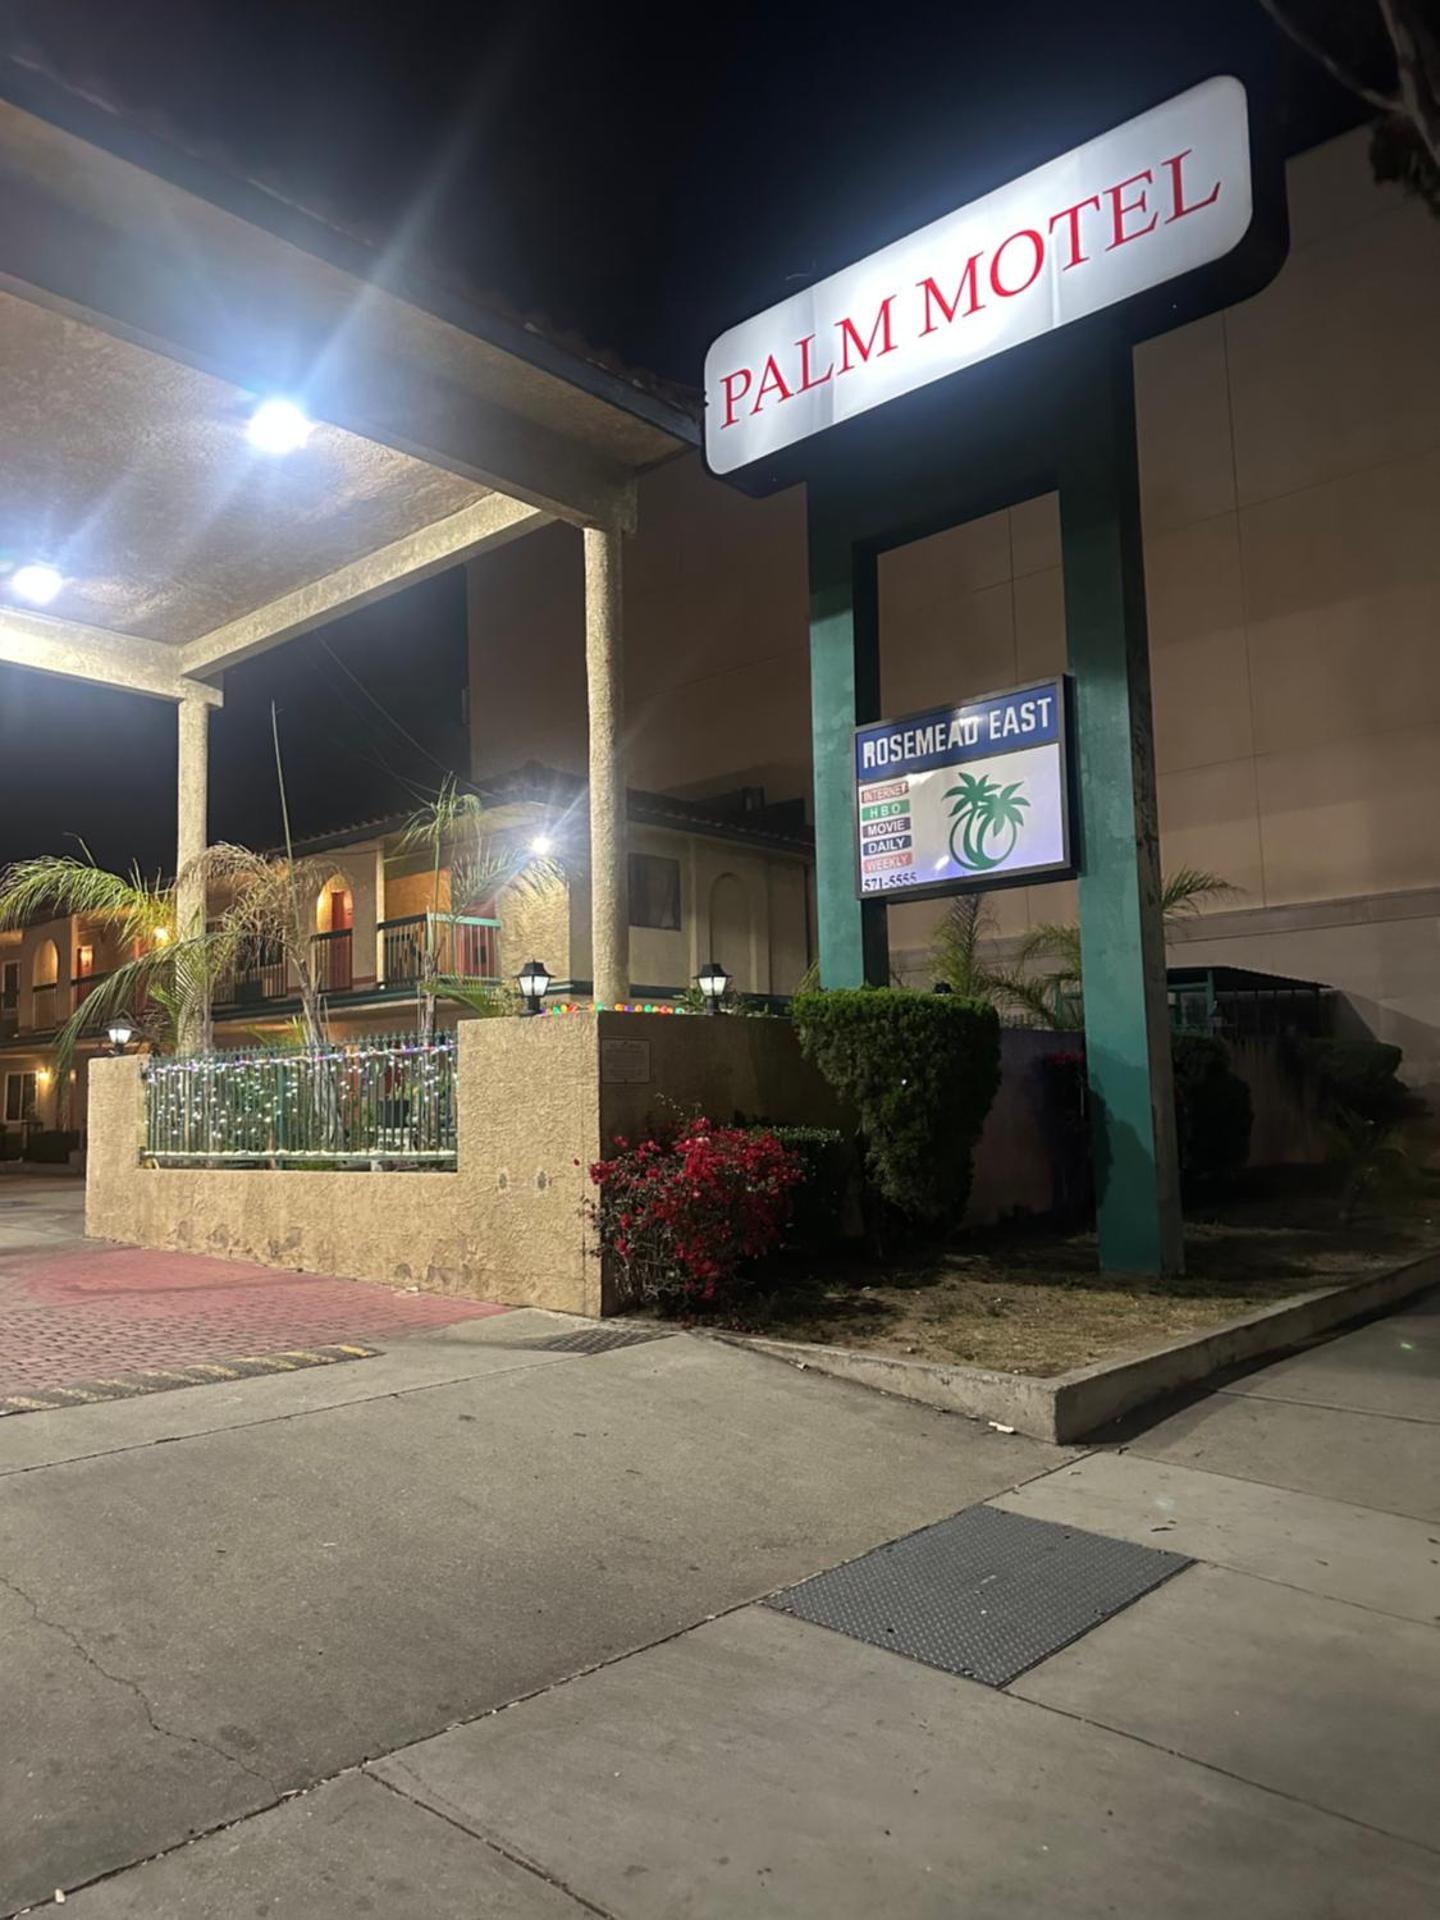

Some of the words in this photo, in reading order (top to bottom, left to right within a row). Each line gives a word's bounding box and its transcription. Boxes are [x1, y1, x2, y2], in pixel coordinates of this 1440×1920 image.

[719, 294, 899, 431] PALM
[915, 149, 1222, 338] MOTEL
[863, 717, 979, 769] ROSEMEAD
[990, 697, 1052, 740] EAST
[863, 782, 907, 803] INTERNET
[869, 803, 901, 819] HBO
[868, 819, 905, 836] MOVIE
[868, 837, 905, 854] DAILY
[865, 854, 909, 871] WEEKLY
